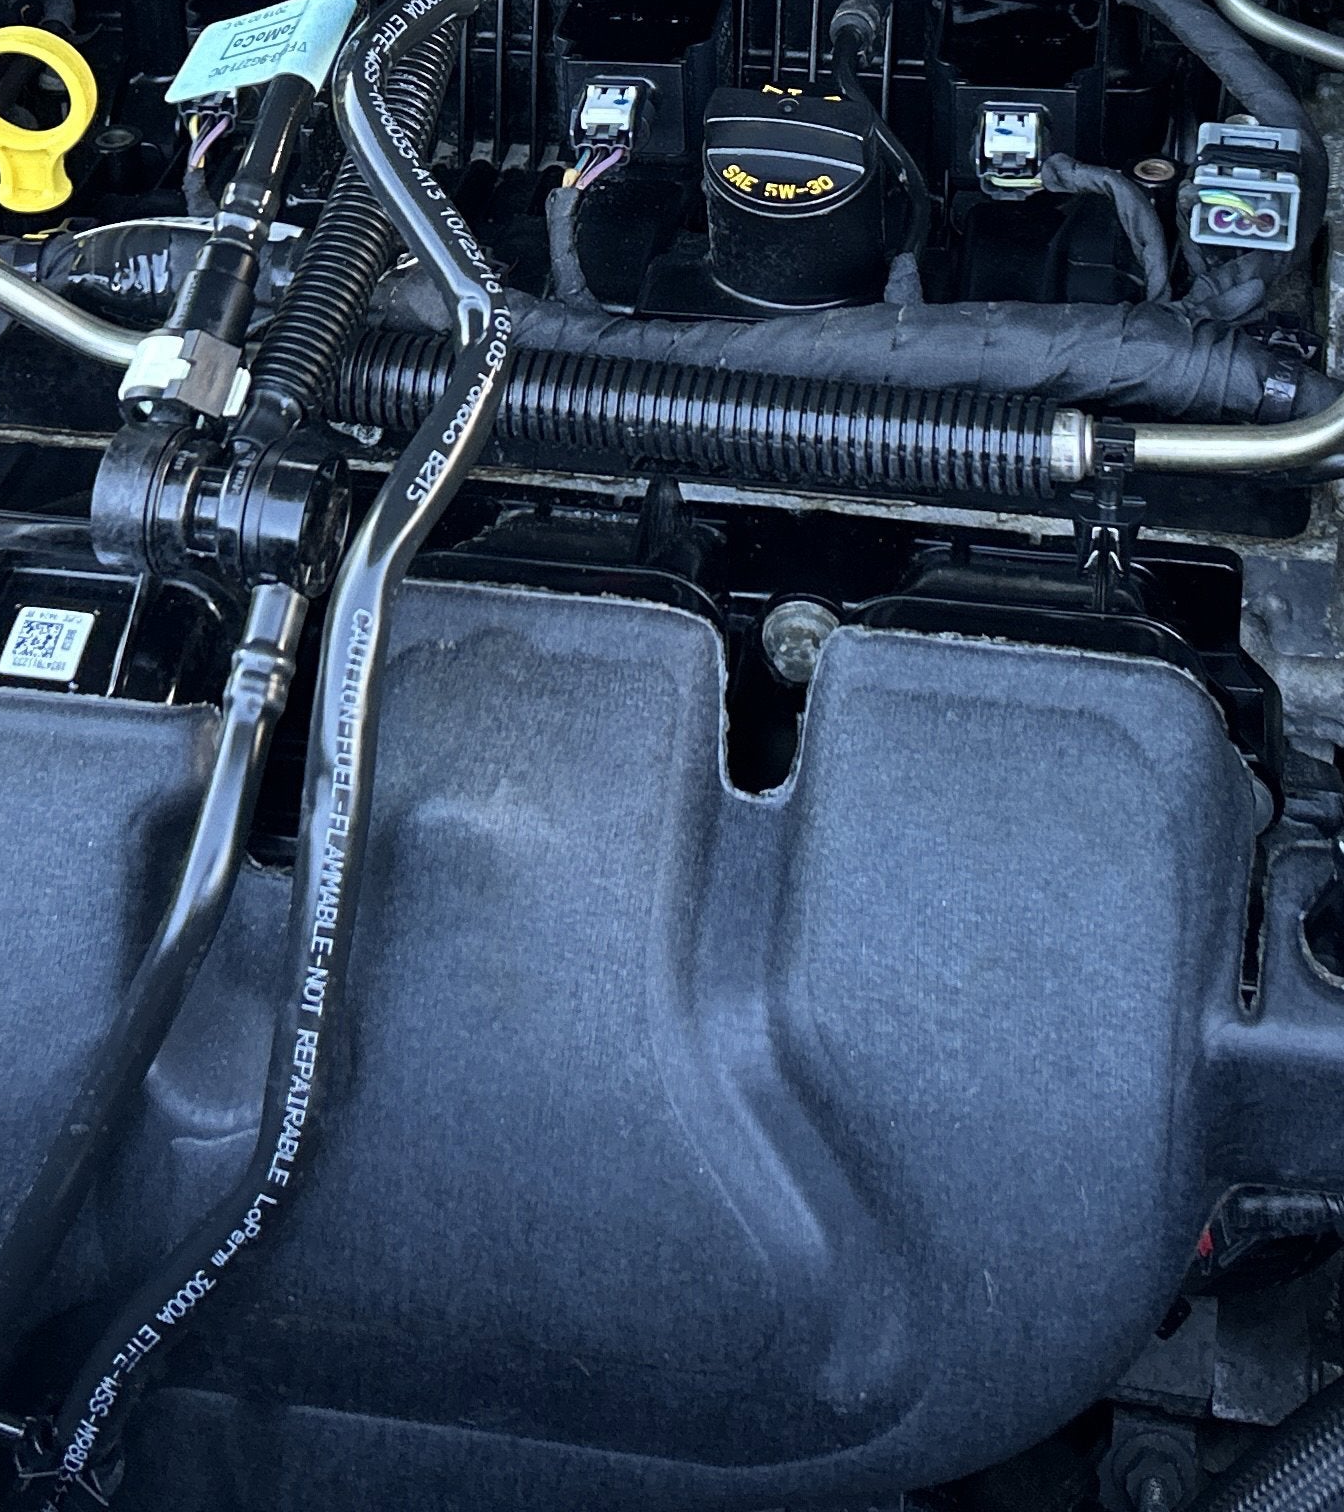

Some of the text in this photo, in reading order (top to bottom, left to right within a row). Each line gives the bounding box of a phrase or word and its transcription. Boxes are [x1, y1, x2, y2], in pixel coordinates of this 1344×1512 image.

[233, 22, 300, 50] FoMoCo
[722, 163, 835, 200] SAE 5W-30
[267, 1027, 319, 1188] REPAIRABLE
[210, 1191, 278, 1268] LoPerm
[155, 1268, 217, 1326] 3000A
